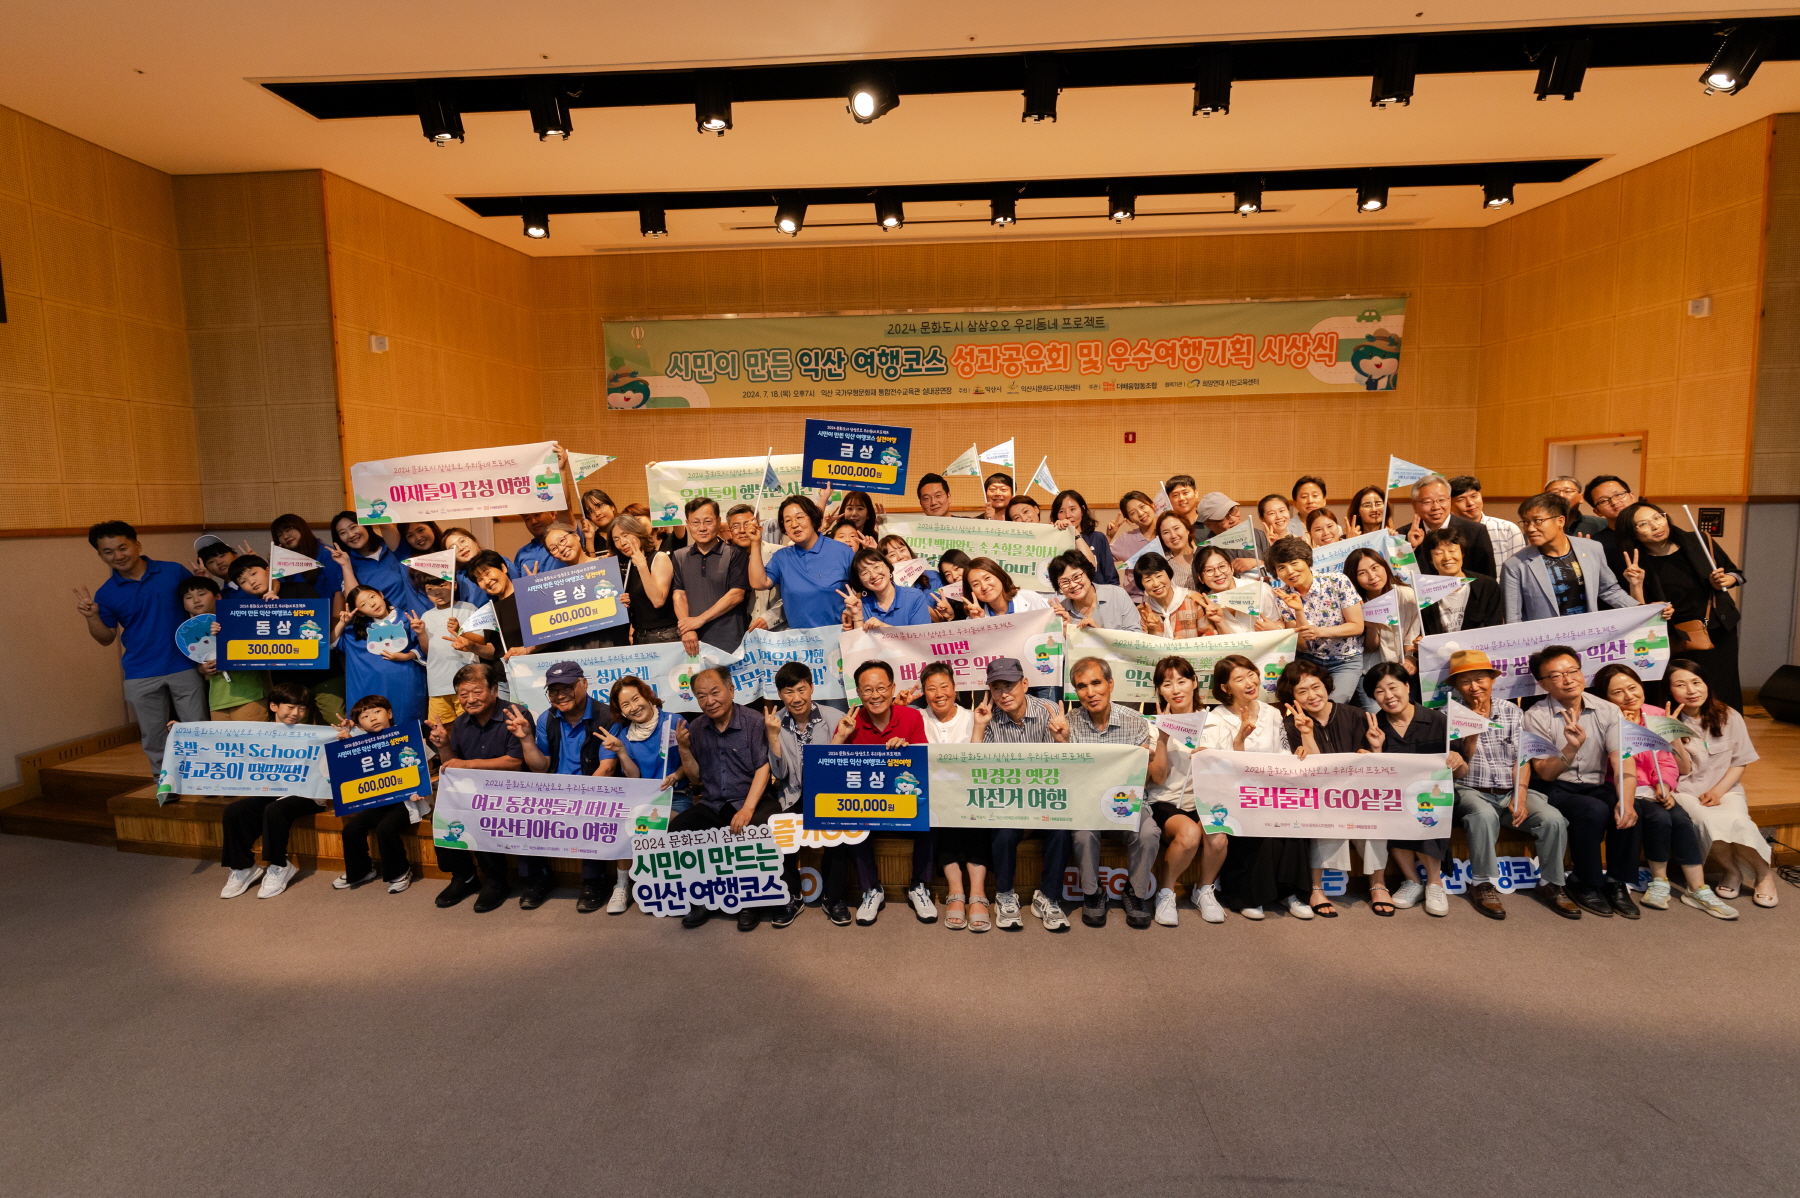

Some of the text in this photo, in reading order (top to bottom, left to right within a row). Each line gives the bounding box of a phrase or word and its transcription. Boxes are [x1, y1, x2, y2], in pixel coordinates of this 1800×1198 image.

[887, 315, 1106, 334] 2024 문화도시 삼삼오오 우리동네 프로젝트
[666, 331, 1338, 383] 시민이 만든 익산 여행코스 성과공유회 및 우수여행기획 시상식
[742, 390, 762, 398] 2024.
[793, 390, 815, 398] 오후7시
[821, 389, 833, 397] 익산
[835, 389, 877, 397] 국가무형문화재
[878, 387, 921, 396] 통합전수교육관
[922, 386, 952, 396] 실내공연장
[985, 386, 1002, 394] 익산시
[1020, 384, 1081, 393] 익산시문화도시지원센터
[1202, 379, 1225, 388] 희망연대
[1225, 378, 1260, 387] 시민교육센터
[840, 442, 874, 459] 금 상
[394, 459, 517, 475] 2024 문화도시 삼삼오오 우리동네 프로젝트
[827, 464, 882, 479] 1,000,000원
[389, 475, 531, 503] 아재들의 감성 여행
[933, 538, 1058, 558] 백제왕도 속 수학을 찾아서
[998, 559, 1037, 576] Tour!
[553, 585, 586, 605] 은 상
[292, 609, 315, 617] 실전여행
[549, 606, 598, 625] 600,000원
[256, 620, 292, 636] 동 상
[881, 622, 1015, 641] 2024 문화도시 삼삼오오 우리동네 프로젝트
[1134, 640, 1162, 650] 문화도시
[1163, 641, 1192, 651] 삼삼오오
[1193, 640, 1223, 651] 우리동네
[1490, 640, 1520, 651] 문화도시
[1522, 636, 1552, 647] 삼삼오오
[1555, 630, 1586, 641] 우리동네
[1587, 624, 1618, 636] 프로젝트
[247, 643, 300, 656] 300,000원
[607, 654, 633, 663] 우리동네
[634, 651, 660, 660] 프로젝트
[802, 648, 824, 663] 기행
[930, 640, 971, 656] 101번
[1587, 639, 1628, 663] 익산
[192, 726, 223, 737] 문화도시
[224, 727, 254, 738] 삼삼오오
[255, 728, 288, 738] 우리동네
[288, 730, 318, 740] 프로젝트
[215, 741, 245, 759] 익산
[248, 743, 321, 761] School!
[938, 751, 1093, 762] 2024 문화도시 삼삼오오 우리동네 프로젝트
[361, 751, 392, 773] 은 상
[817, 758, 912, 767] 시민이 만든 익산 여행코스 실전여행
[178, 760, 309, 783] 학교종이 땡땡땡!
[846, 771, 885, 789] 동 상
[971, 767, 1060, 785] 만경강 옛강
[1244, 765, 1398, 778] 2024 문화도시 삼삼오오 우리동네 프로젝트
[357, 775, 403, 794] 600,000원
[485, 778, 625, 795] 2024 문화도시 삼삼오오 우리동네 프로젝트
[471, 793, 631, 819] 여고 동창생들과 떠나는
[836, 798, 895, 813] 300,000원
[966, 787, 1067, 811] 자전거 여행
[1239, 785, 1320, 810] 둘러둘러
[479, 816, 618, 844] 익산티아Go 여행
[633, 838, 666, 851] 2024
[668, 833, 718, 849] 문화도시
[633, 842, 779, 880] 시민이 만드는
[637, 875, 785, 912] 익산 여행코스
